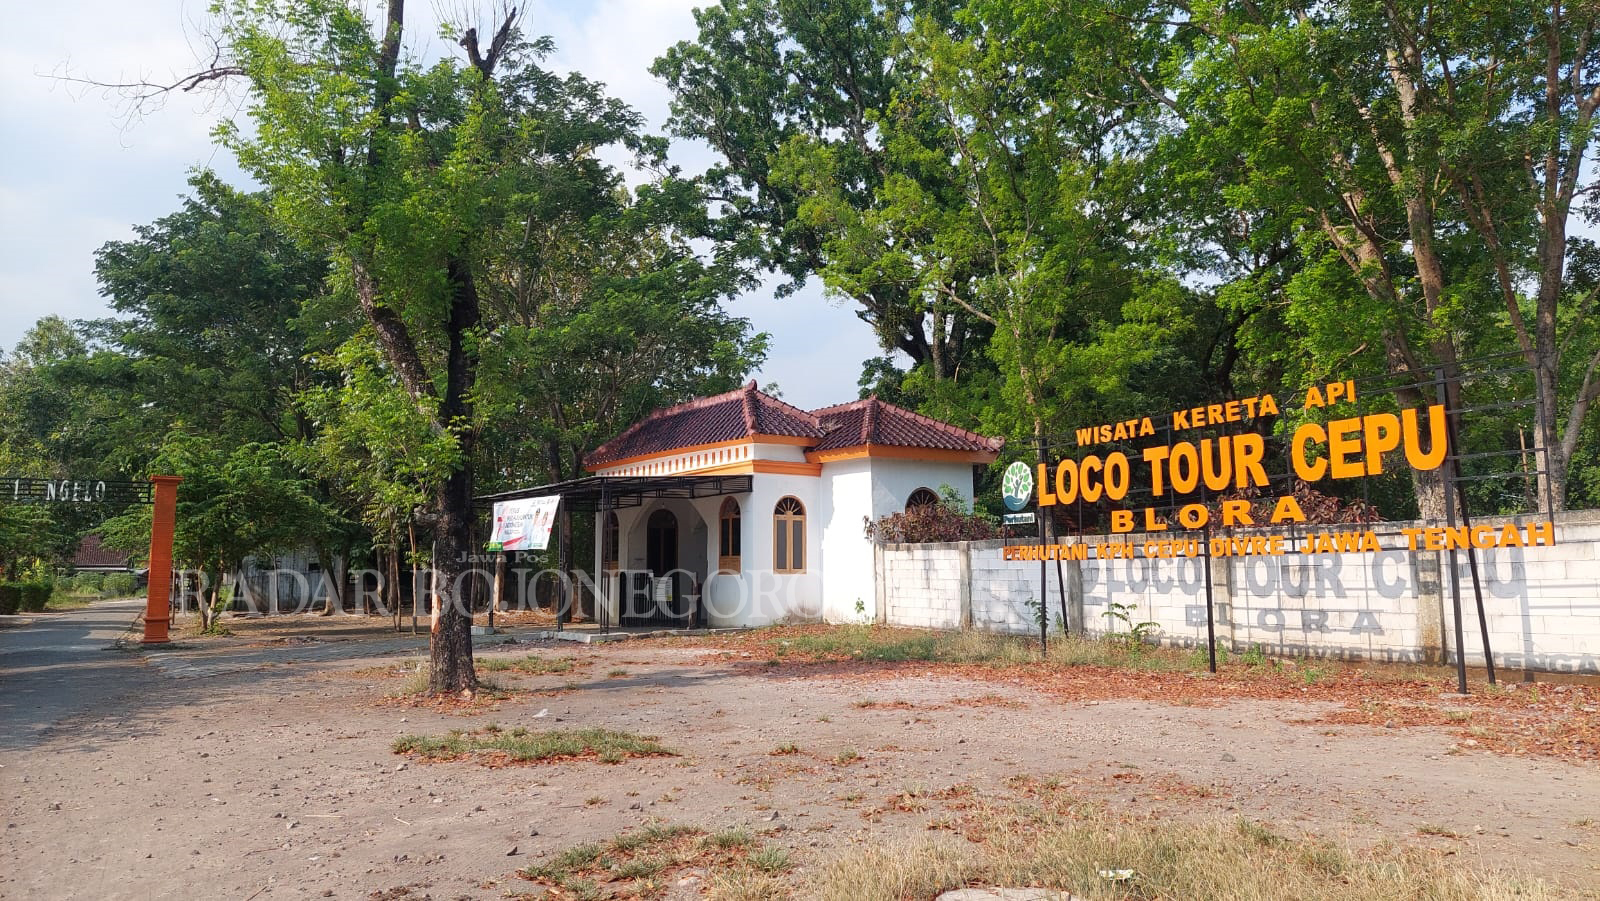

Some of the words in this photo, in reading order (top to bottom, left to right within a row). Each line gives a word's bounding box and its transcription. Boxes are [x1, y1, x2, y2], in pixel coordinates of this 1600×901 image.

[1075, 417, 1155, 446] WISATA
[1173, 394, 1280, 431] KERETA
[1303, 379, 1357, 410] API
[1037, 451, 1130, 507] LOCO
[1143, 434, 1269, 497] TOUR
[1291, 405, 1449, 482] CEPU
[1002, 543, 1088, 562] PERHUTANI
[1096, 541, 1135, 560] KPH
[1143, 539, 1199, 559] CEPU
[1209, 535, 1286, 558] DIVRE
[1300, 530, 1383, 555] JAWA
[1400, 521, 1555, 552] TENGAH
[1111, 495, 1308, 534] BLORA
